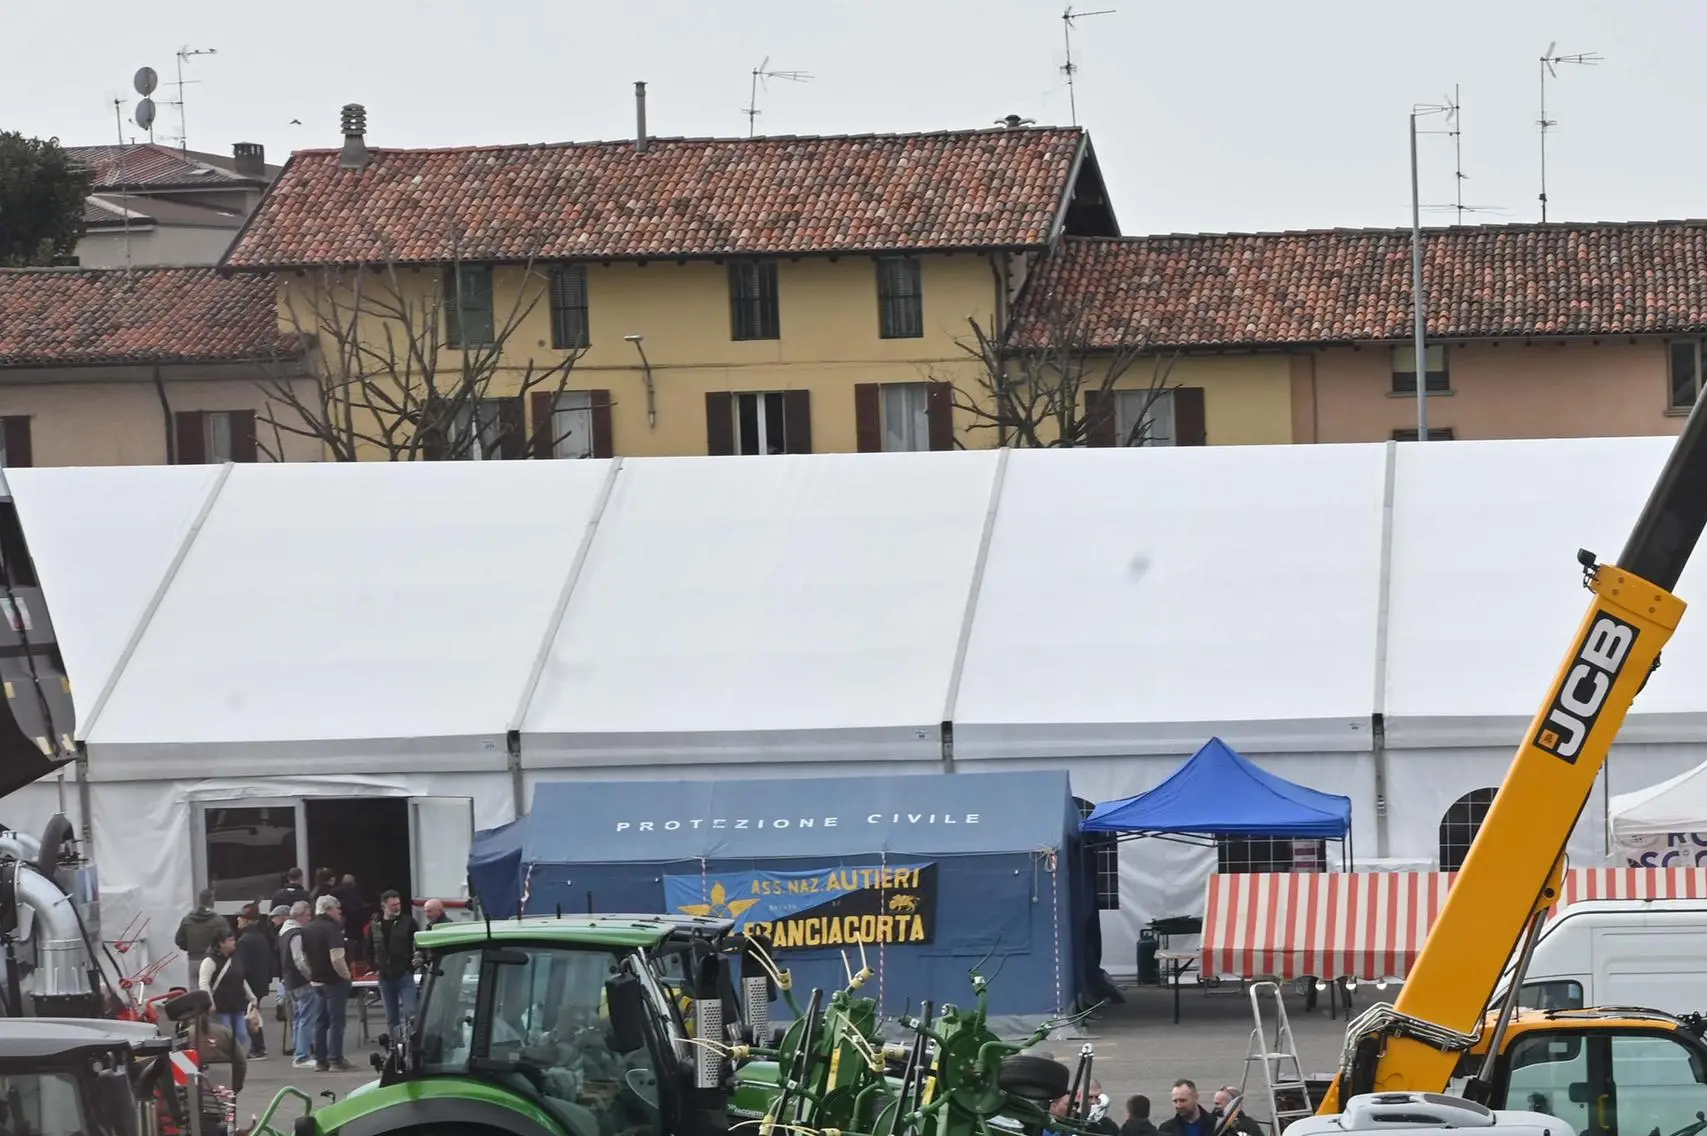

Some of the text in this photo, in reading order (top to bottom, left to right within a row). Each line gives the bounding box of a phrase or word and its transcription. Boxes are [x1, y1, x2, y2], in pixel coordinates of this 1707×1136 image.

[1549, 618, 1633, 757] JCB
[616, 813, 980, 832] PROTEZIONE CIVILE
[827, 867, 920, 891] AUTIERI
